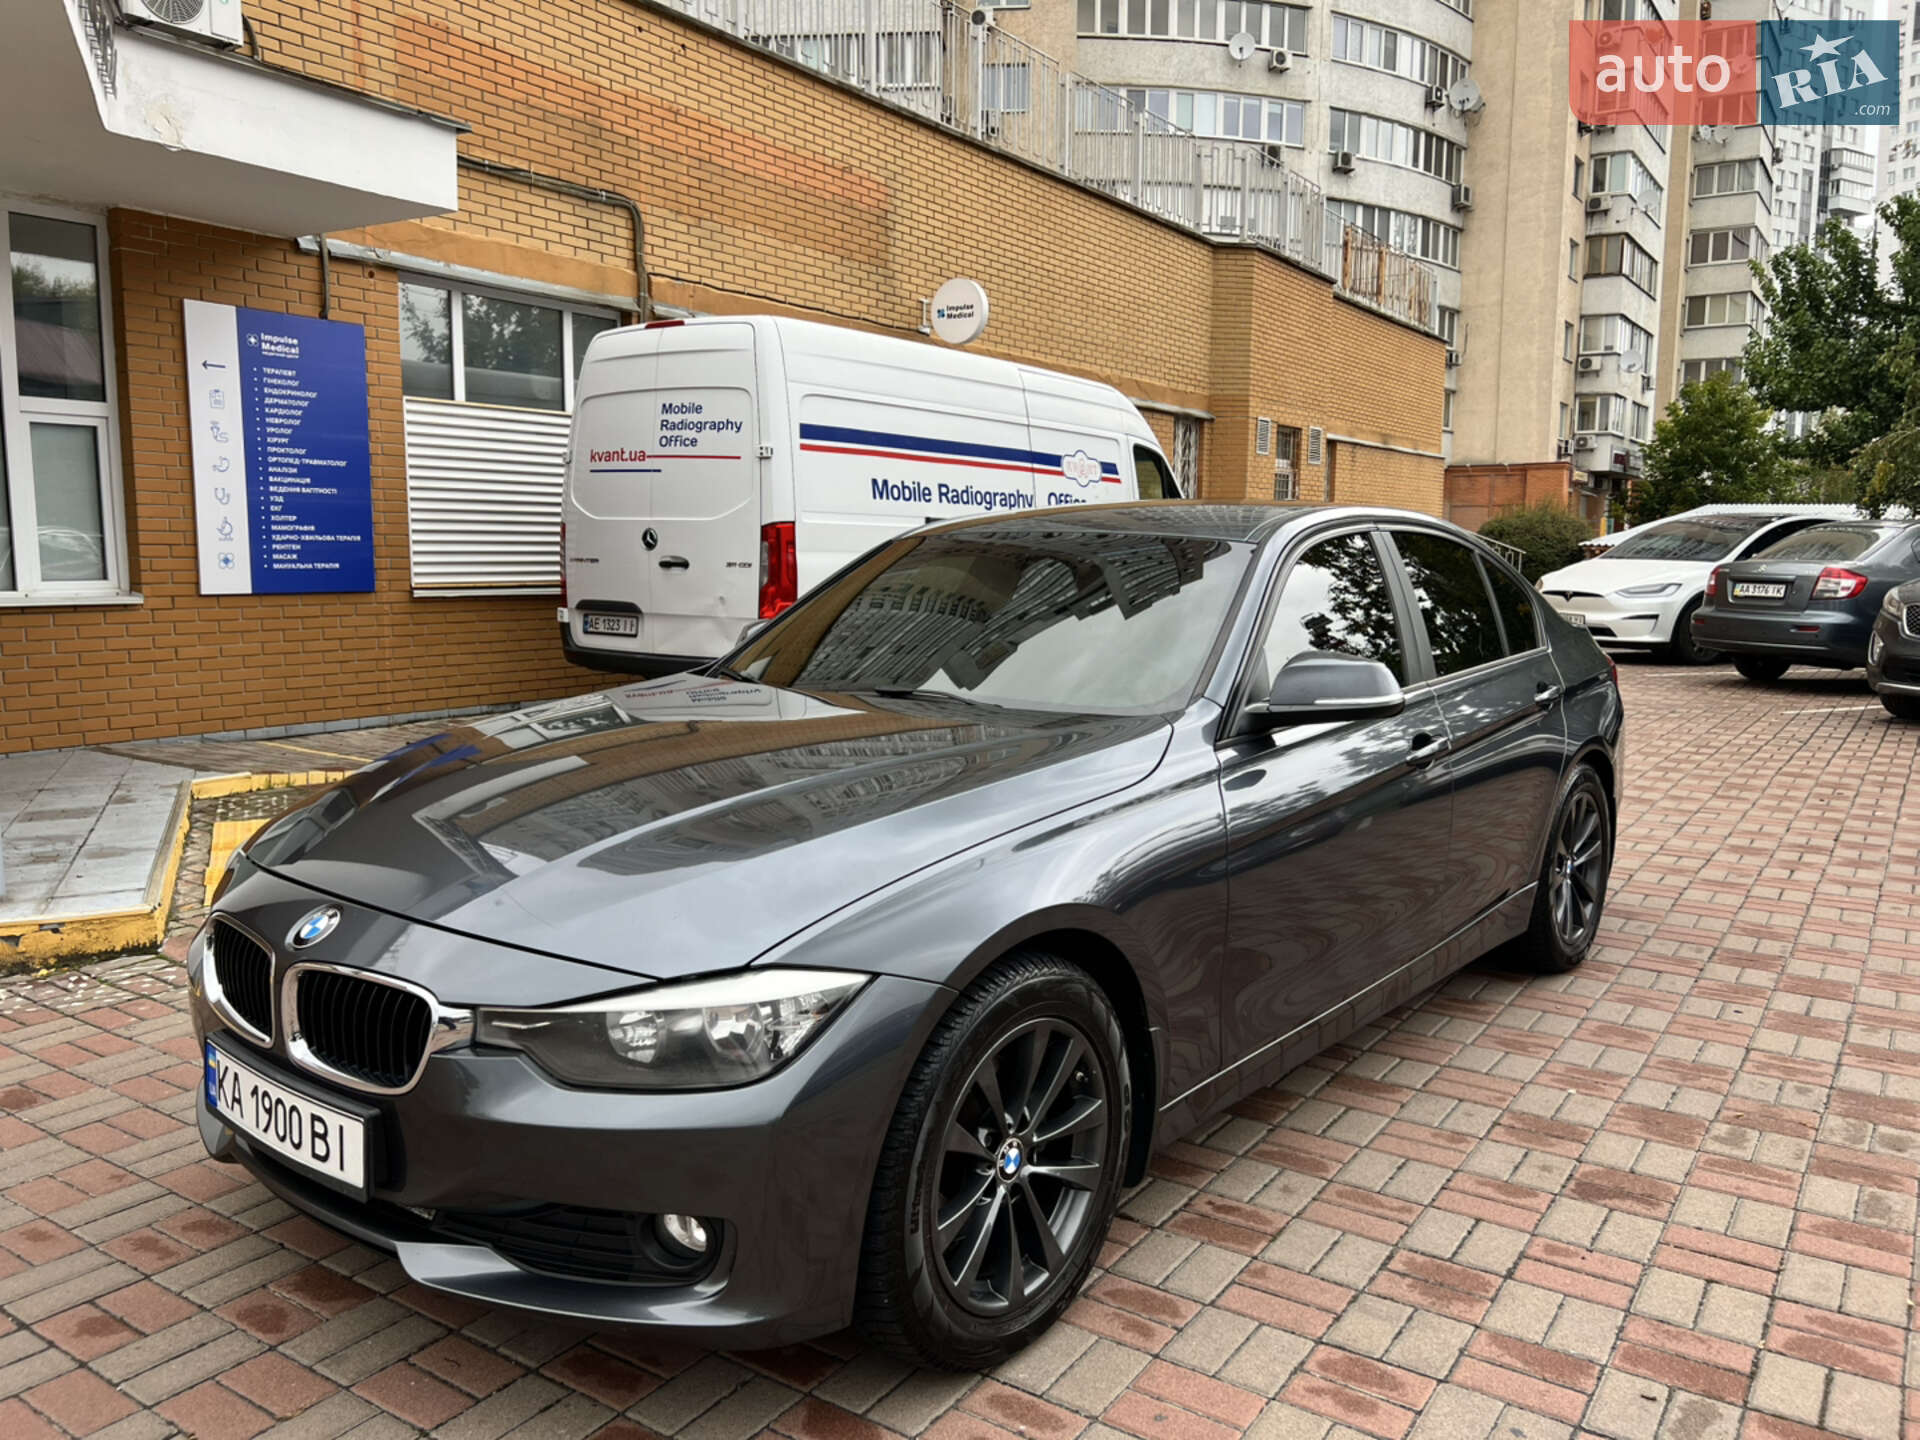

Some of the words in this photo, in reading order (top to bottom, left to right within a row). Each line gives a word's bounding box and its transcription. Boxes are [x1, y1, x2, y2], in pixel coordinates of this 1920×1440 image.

[946, 304, 974, 312] Impulse
[946, 311, 974, 319] Medical
[260, 332, 298, 345] Impulse
[261, 342, 299, 354] Medical
[661, 402, 703, 416] Mobile
[660, 418, 743, 433] Radiography
[659, 435, 698, 449] Office
[590, 448, 646, 463] kvant.ua
[871, 477, 932, 503] Mobile
[937, 483, 1034, 511] Radiography
[603, 618, 621, 632] 1323
[217, 1059, 244, 1118] KA
[250, 1085, 303, 1150] 1900
[310, 1112, 345, 1172] BI
